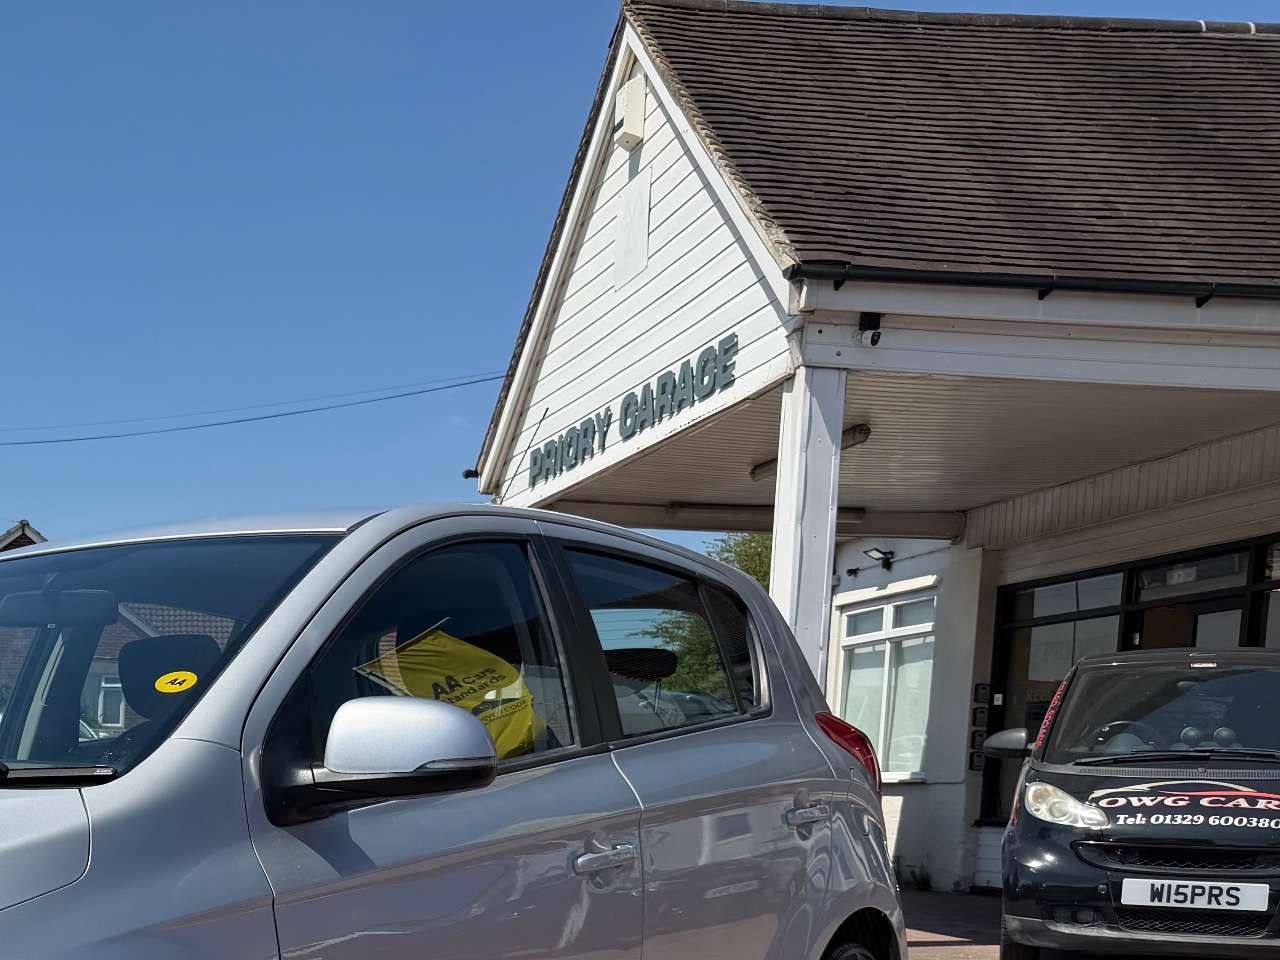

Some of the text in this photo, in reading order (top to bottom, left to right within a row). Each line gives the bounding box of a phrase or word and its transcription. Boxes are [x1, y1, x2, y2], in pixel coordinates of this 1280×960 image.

[528, 331, 739, 491] PRIORY GARAGE
[165, 678, 187, 686] AA
[432, 667, 496, 700] AA Cars
[440, 673, 506, 704] tandards
[1098, 796, 1191, 808] OWG
[1116, 813, 1280, 829] Tel: 01329 600380
